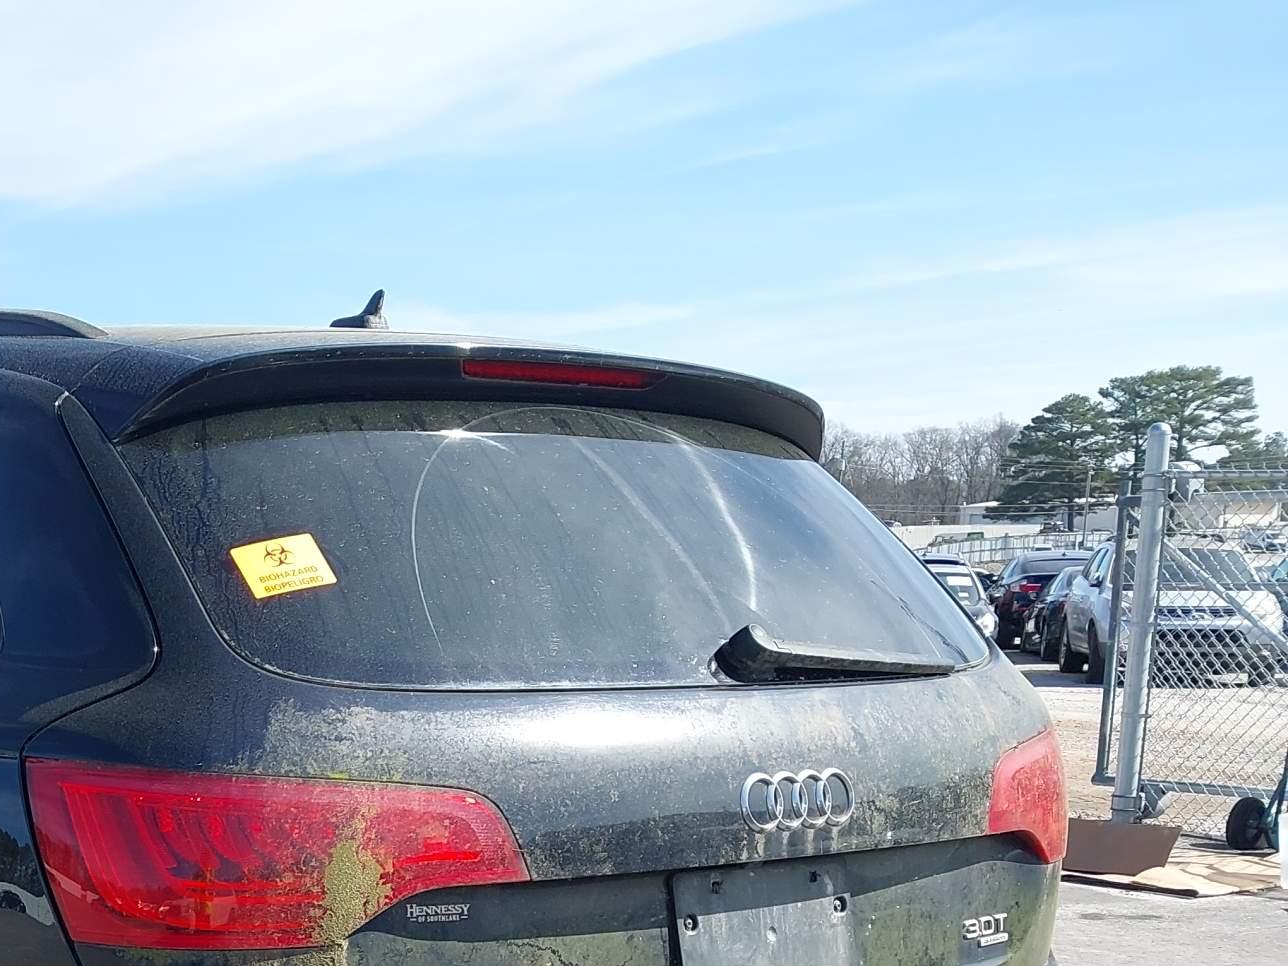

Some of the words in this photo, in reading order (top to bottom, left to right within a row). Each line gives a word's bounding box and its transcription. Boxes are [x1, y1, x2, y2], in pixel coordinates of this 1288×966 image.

[258, 565, 319, 584] BIOHAZARD
[264, 575, 324, 593] BIOPELIGRO
[406, 904, 471, 918] HENNESSY
[427, 914, 460, 922] SOUTHLAKE
